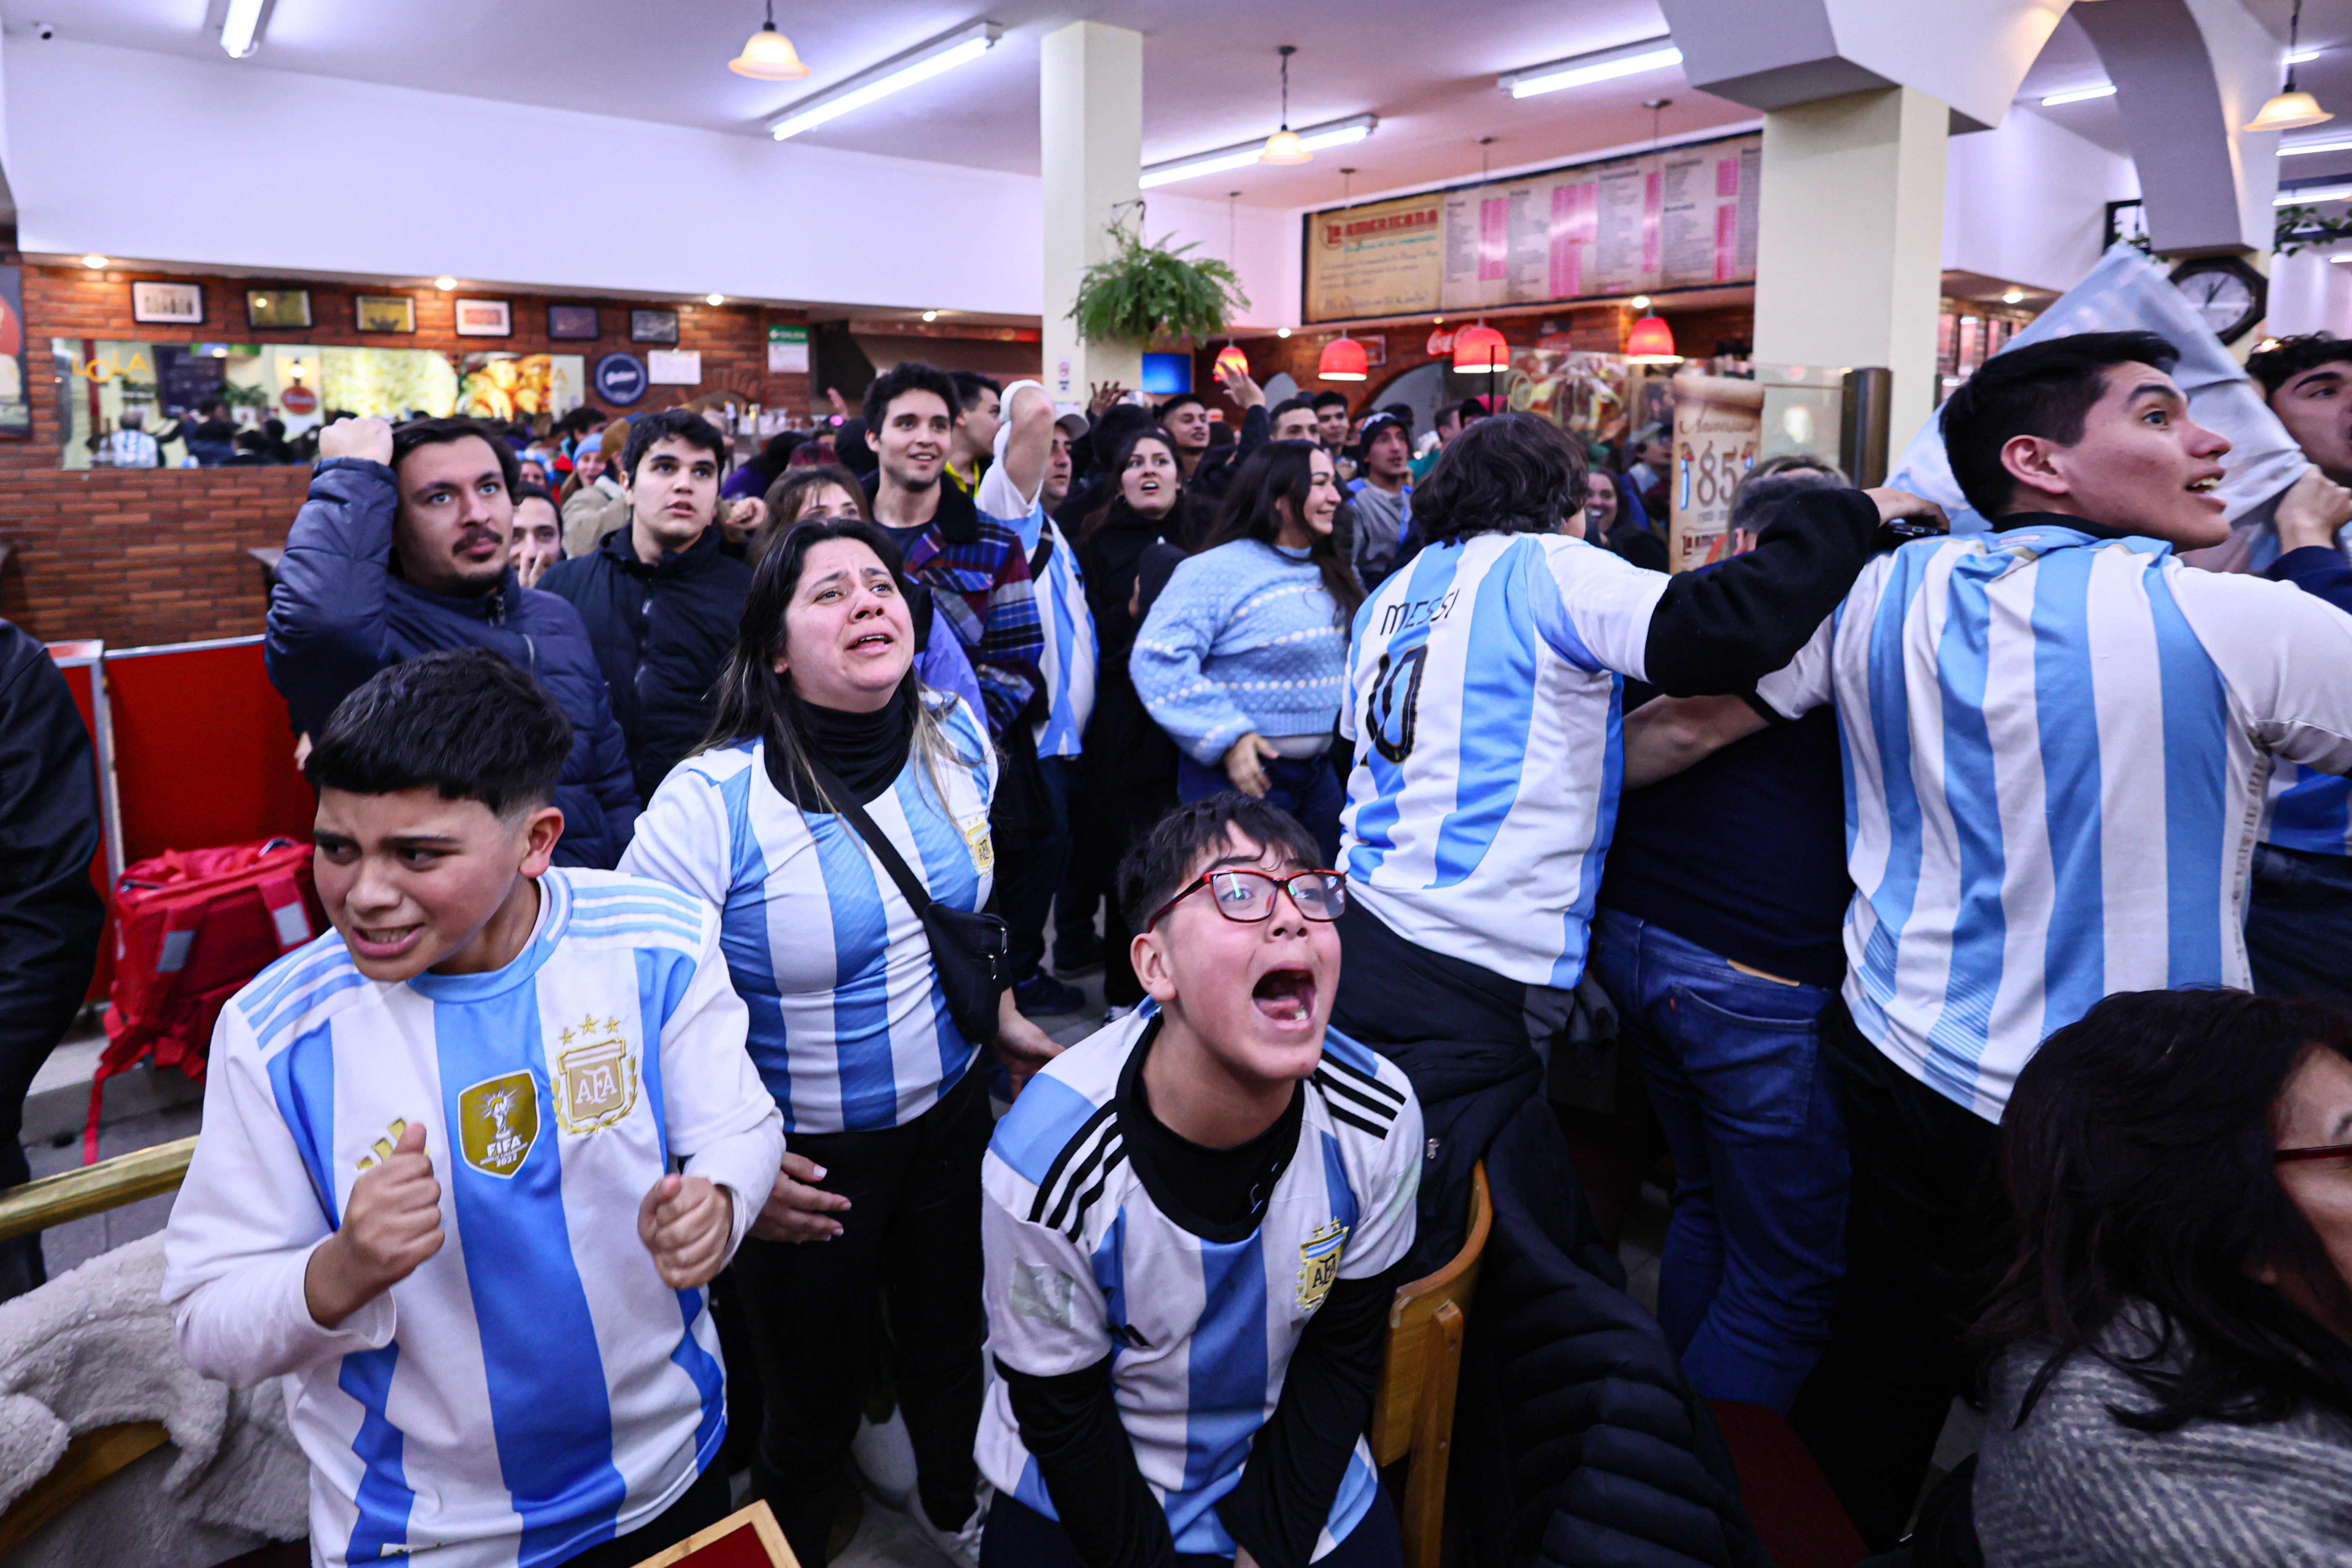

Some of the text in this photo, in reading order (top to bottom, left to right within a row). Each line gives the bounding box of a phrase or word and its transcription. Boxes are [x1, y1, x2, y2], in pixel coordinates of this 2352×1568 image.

[1697, 441, 1738, 507] 85
[1380, 588, 1460, 635] MESSI
[1360, 643, 1429, 767] 10
[575, 1065, 618, 1105] AFA
[486, 1134, 522, 1157] FIFA
[496, 1152, 518, 1168] 2022
[1311, 1253, 1337, 1288] AFA
